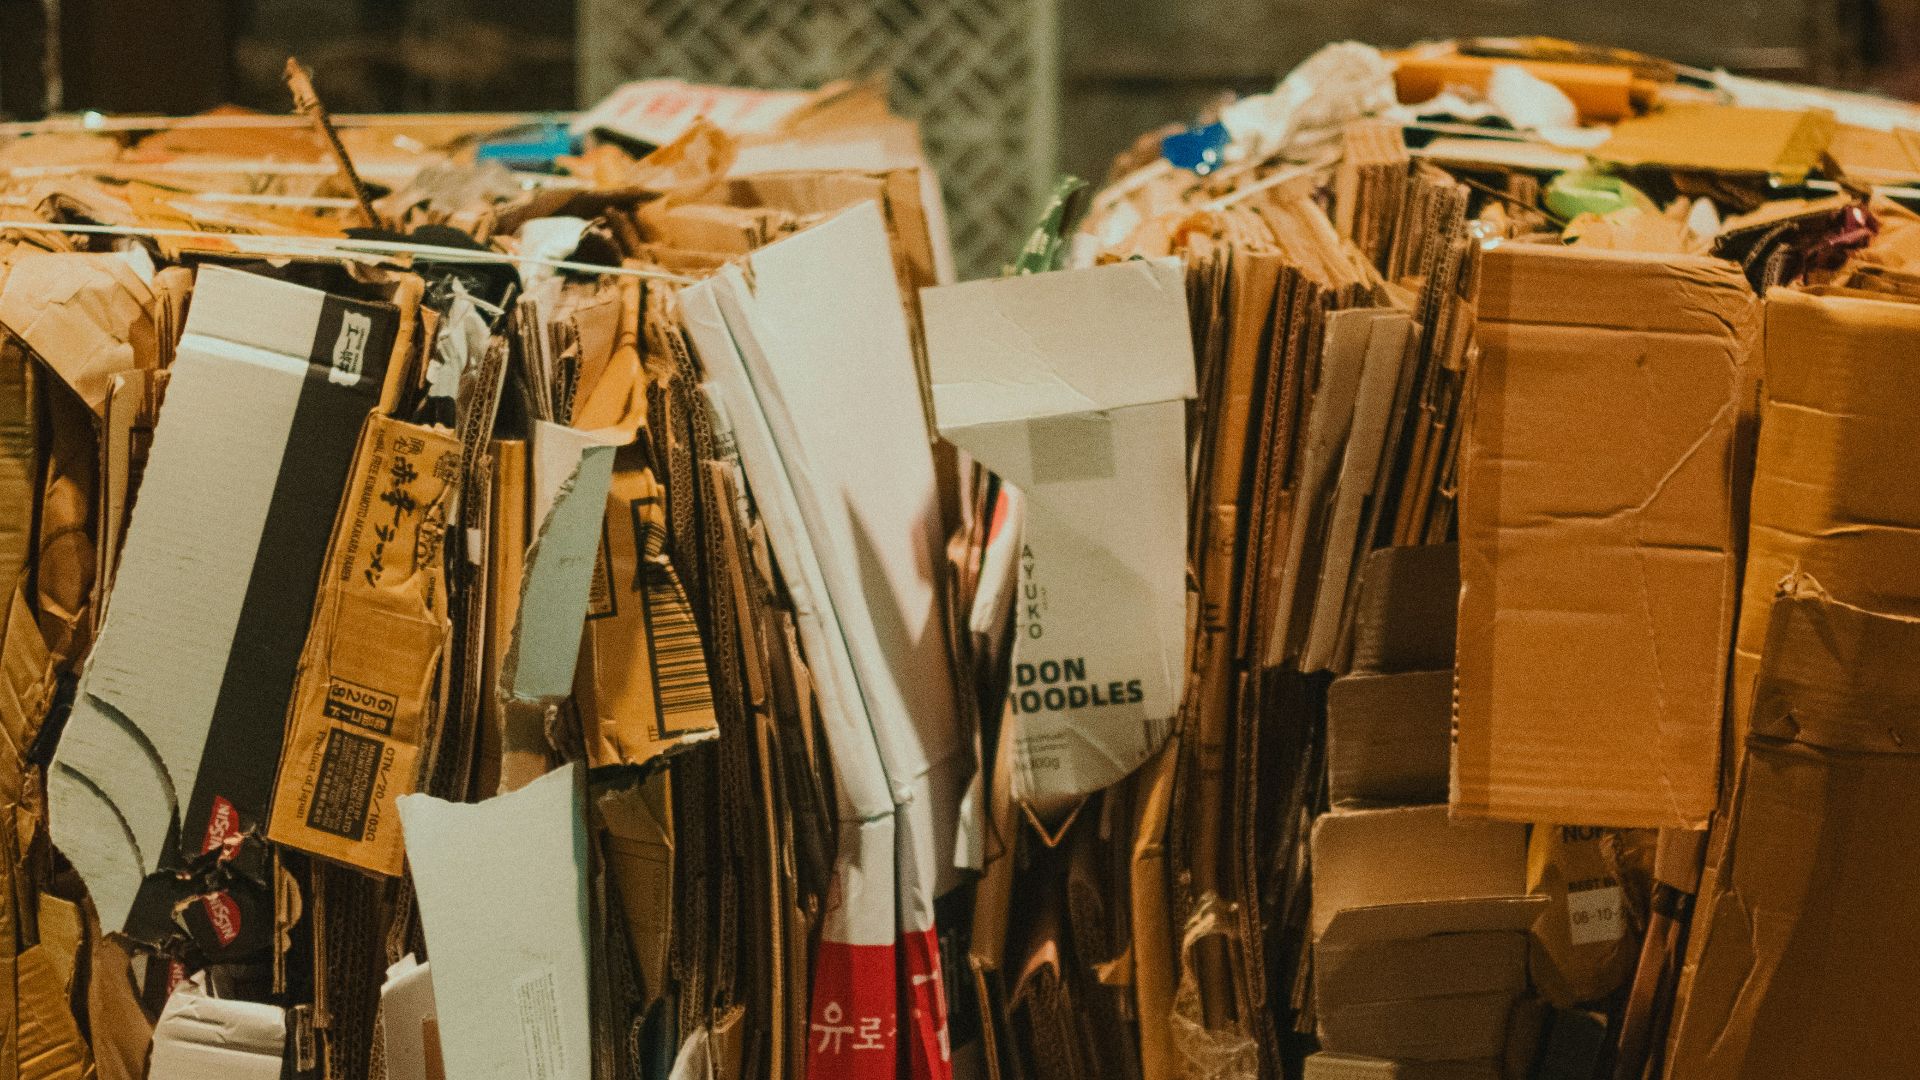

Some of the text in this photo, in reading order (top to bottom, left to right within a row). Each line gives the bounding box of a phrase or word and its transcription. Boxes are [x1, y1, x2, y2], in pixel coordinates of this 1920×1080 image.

[358, 475, 377, 518] KUMAMOTO
[348, 518, 365, 555] AKAKARA
[340, 553, 354, 582] RAMEN
[331, 684, 393, 713] 6528
[306, 773, 317, 787] of
